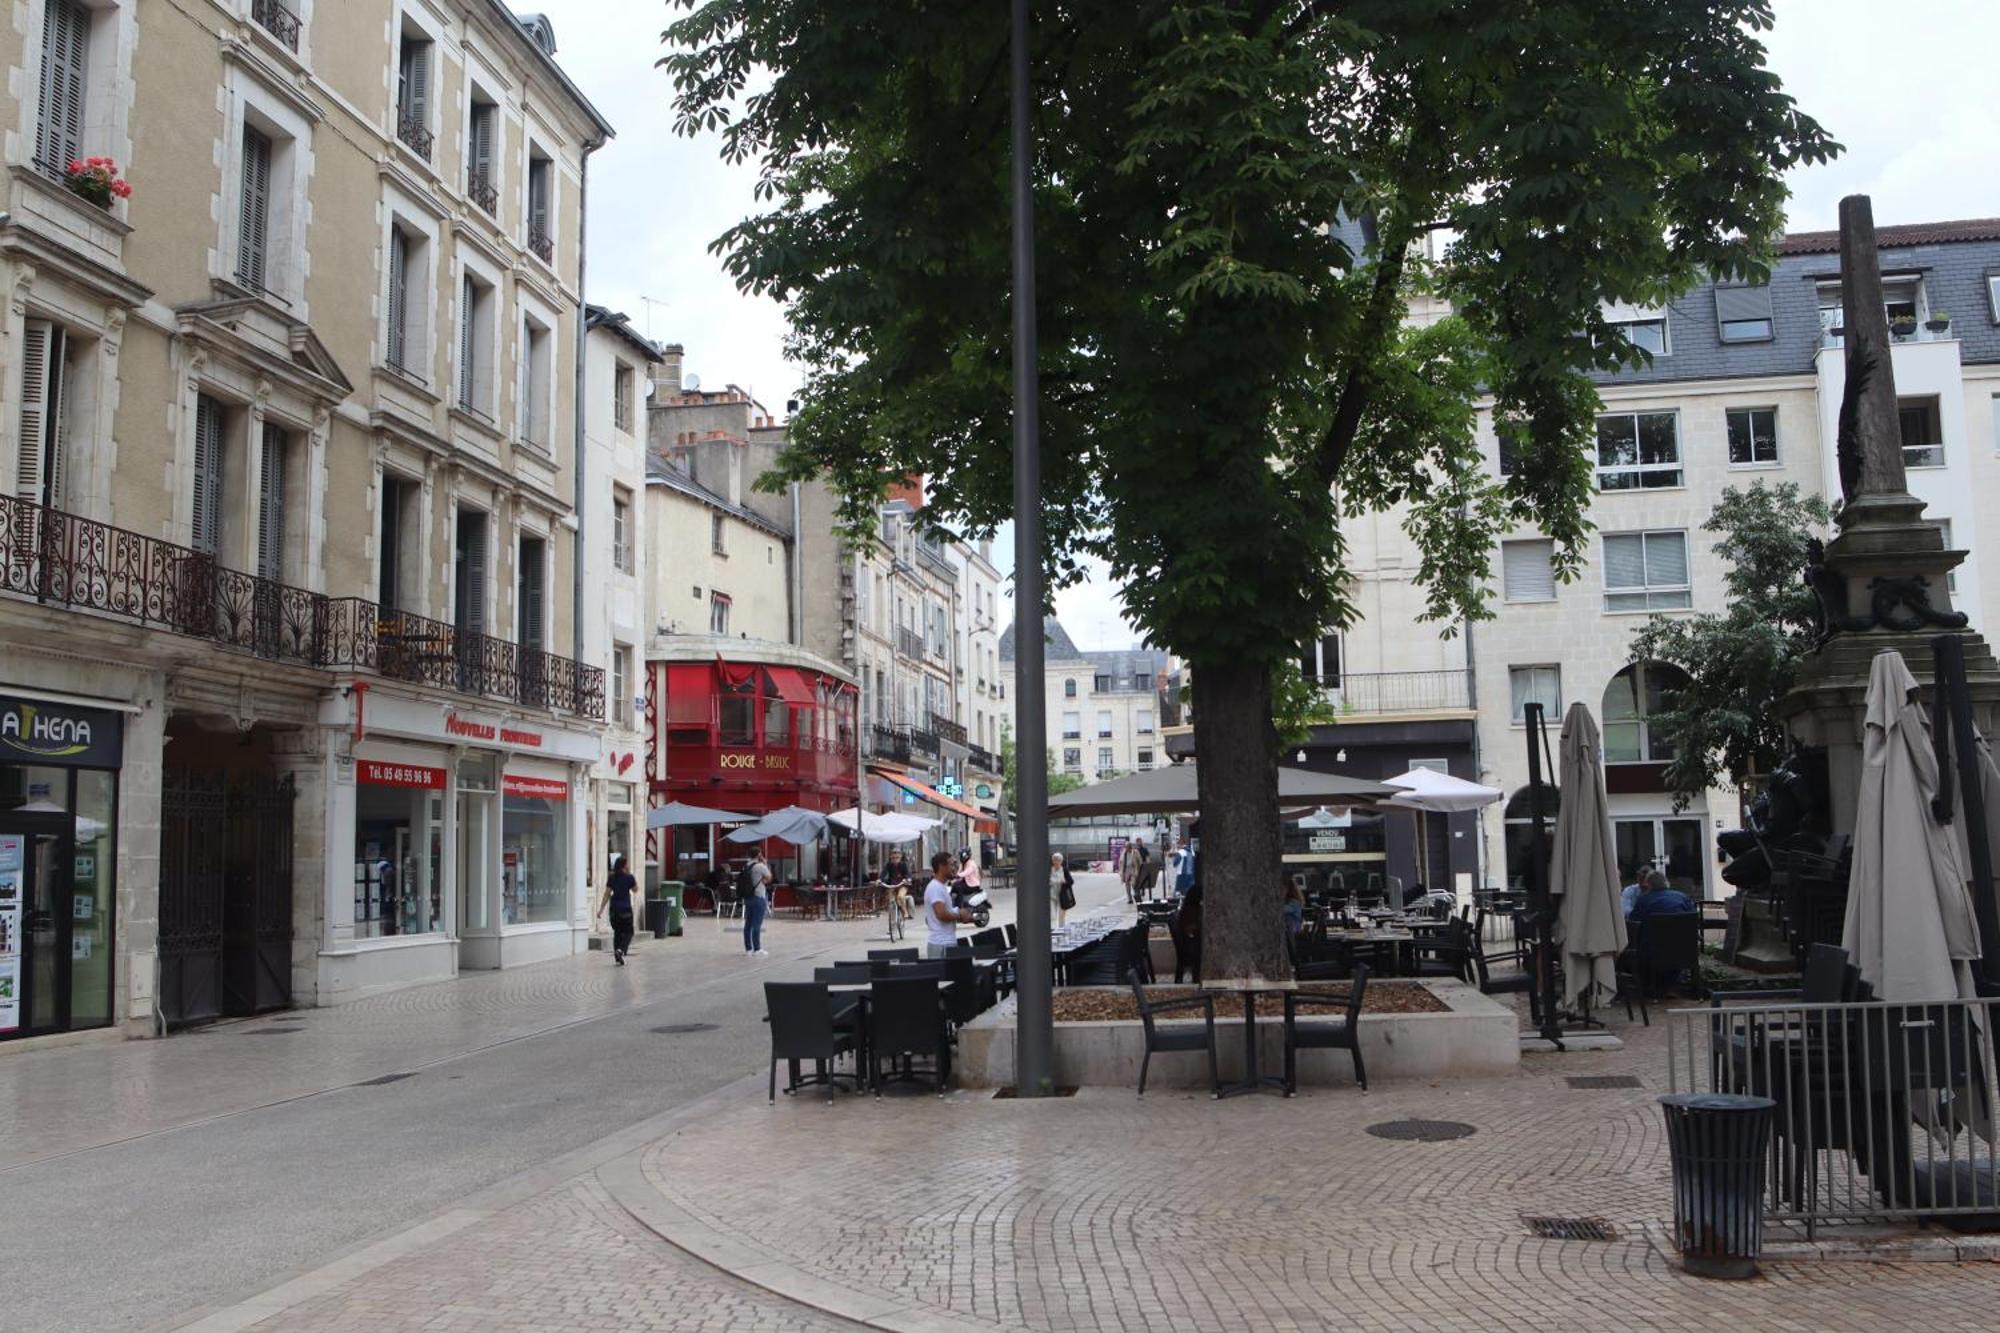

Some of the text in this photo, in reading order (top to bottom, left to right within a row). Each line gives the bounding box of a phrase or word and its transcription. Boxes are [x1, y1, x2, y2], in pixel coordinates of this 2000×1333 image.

[2, 704, 91, 744] ATHENA
[720, 753, 756, 769] ROUGE
[384, 767, 393, 780] 05
[394, 768, 403, 782] 49
[404, 769, 413, 782] 55
